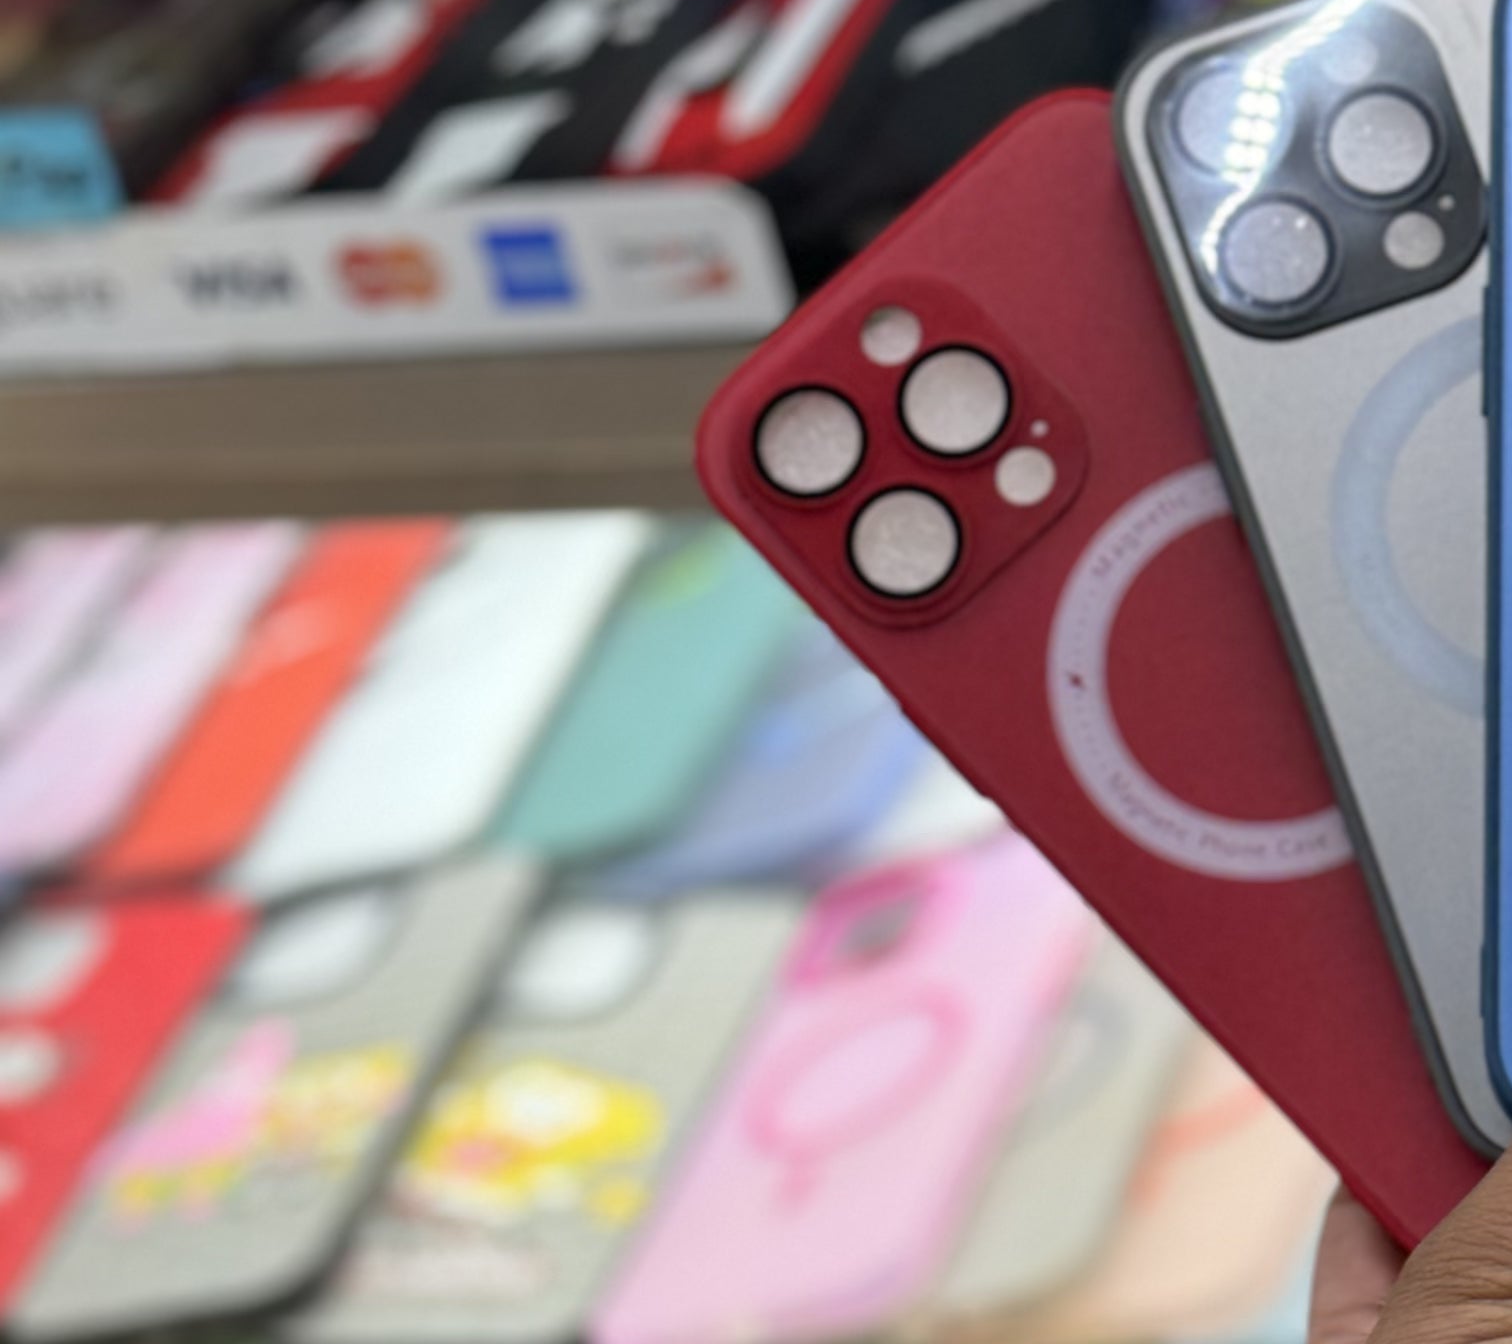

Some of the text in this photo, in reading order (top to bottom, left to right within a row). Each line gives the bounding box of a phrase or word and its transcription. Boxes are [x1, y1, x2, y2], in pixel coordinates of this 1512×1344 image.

[1092, 490, 1191, 578] Magnetic
[1109, 773, 1329, 858] Magnetic Phone Case
